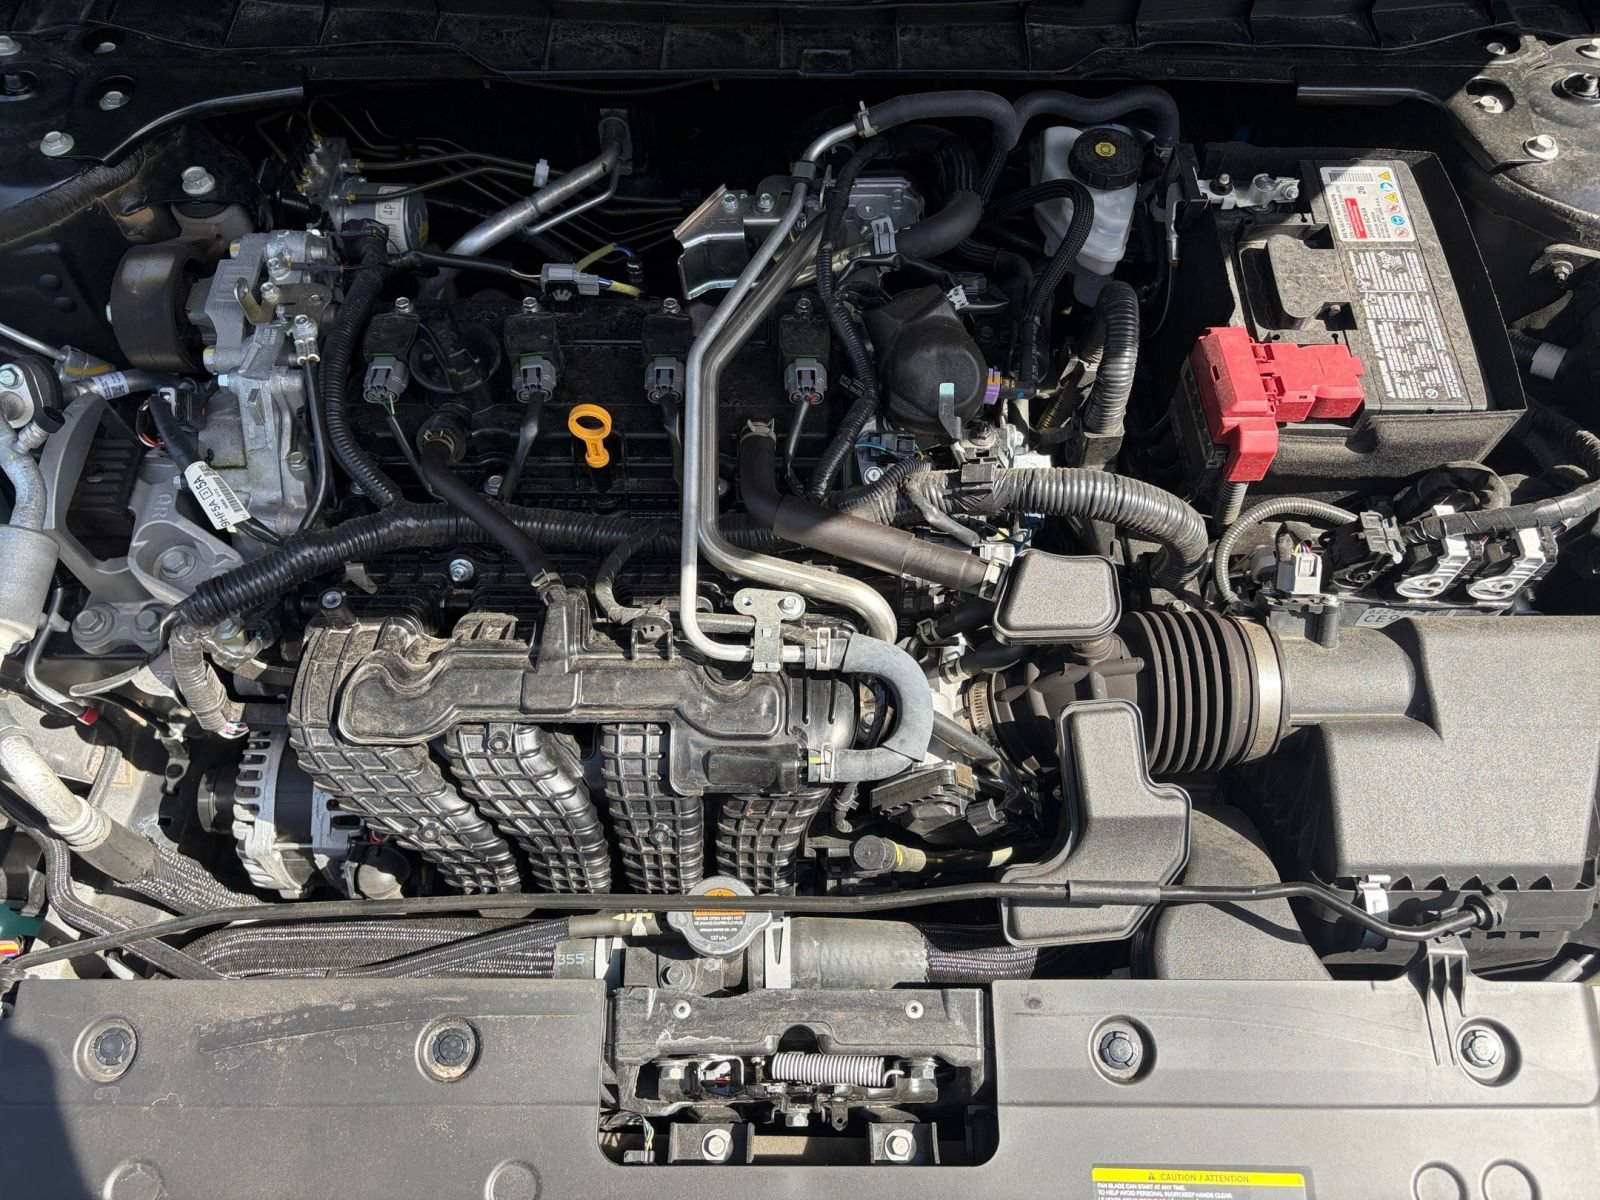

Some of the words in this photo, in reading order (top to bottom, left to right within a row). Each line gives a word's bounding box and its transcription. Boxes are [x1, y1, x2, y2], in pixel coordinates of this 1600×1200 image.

[1356, 186, 1366, 194] 26
[1330, 194, 1340, 215] NISSAN
[194, 475, 207, 490] 5A
[209, 500, 230, 528] 9HF5A
[557, 953, 584, 965] 355
